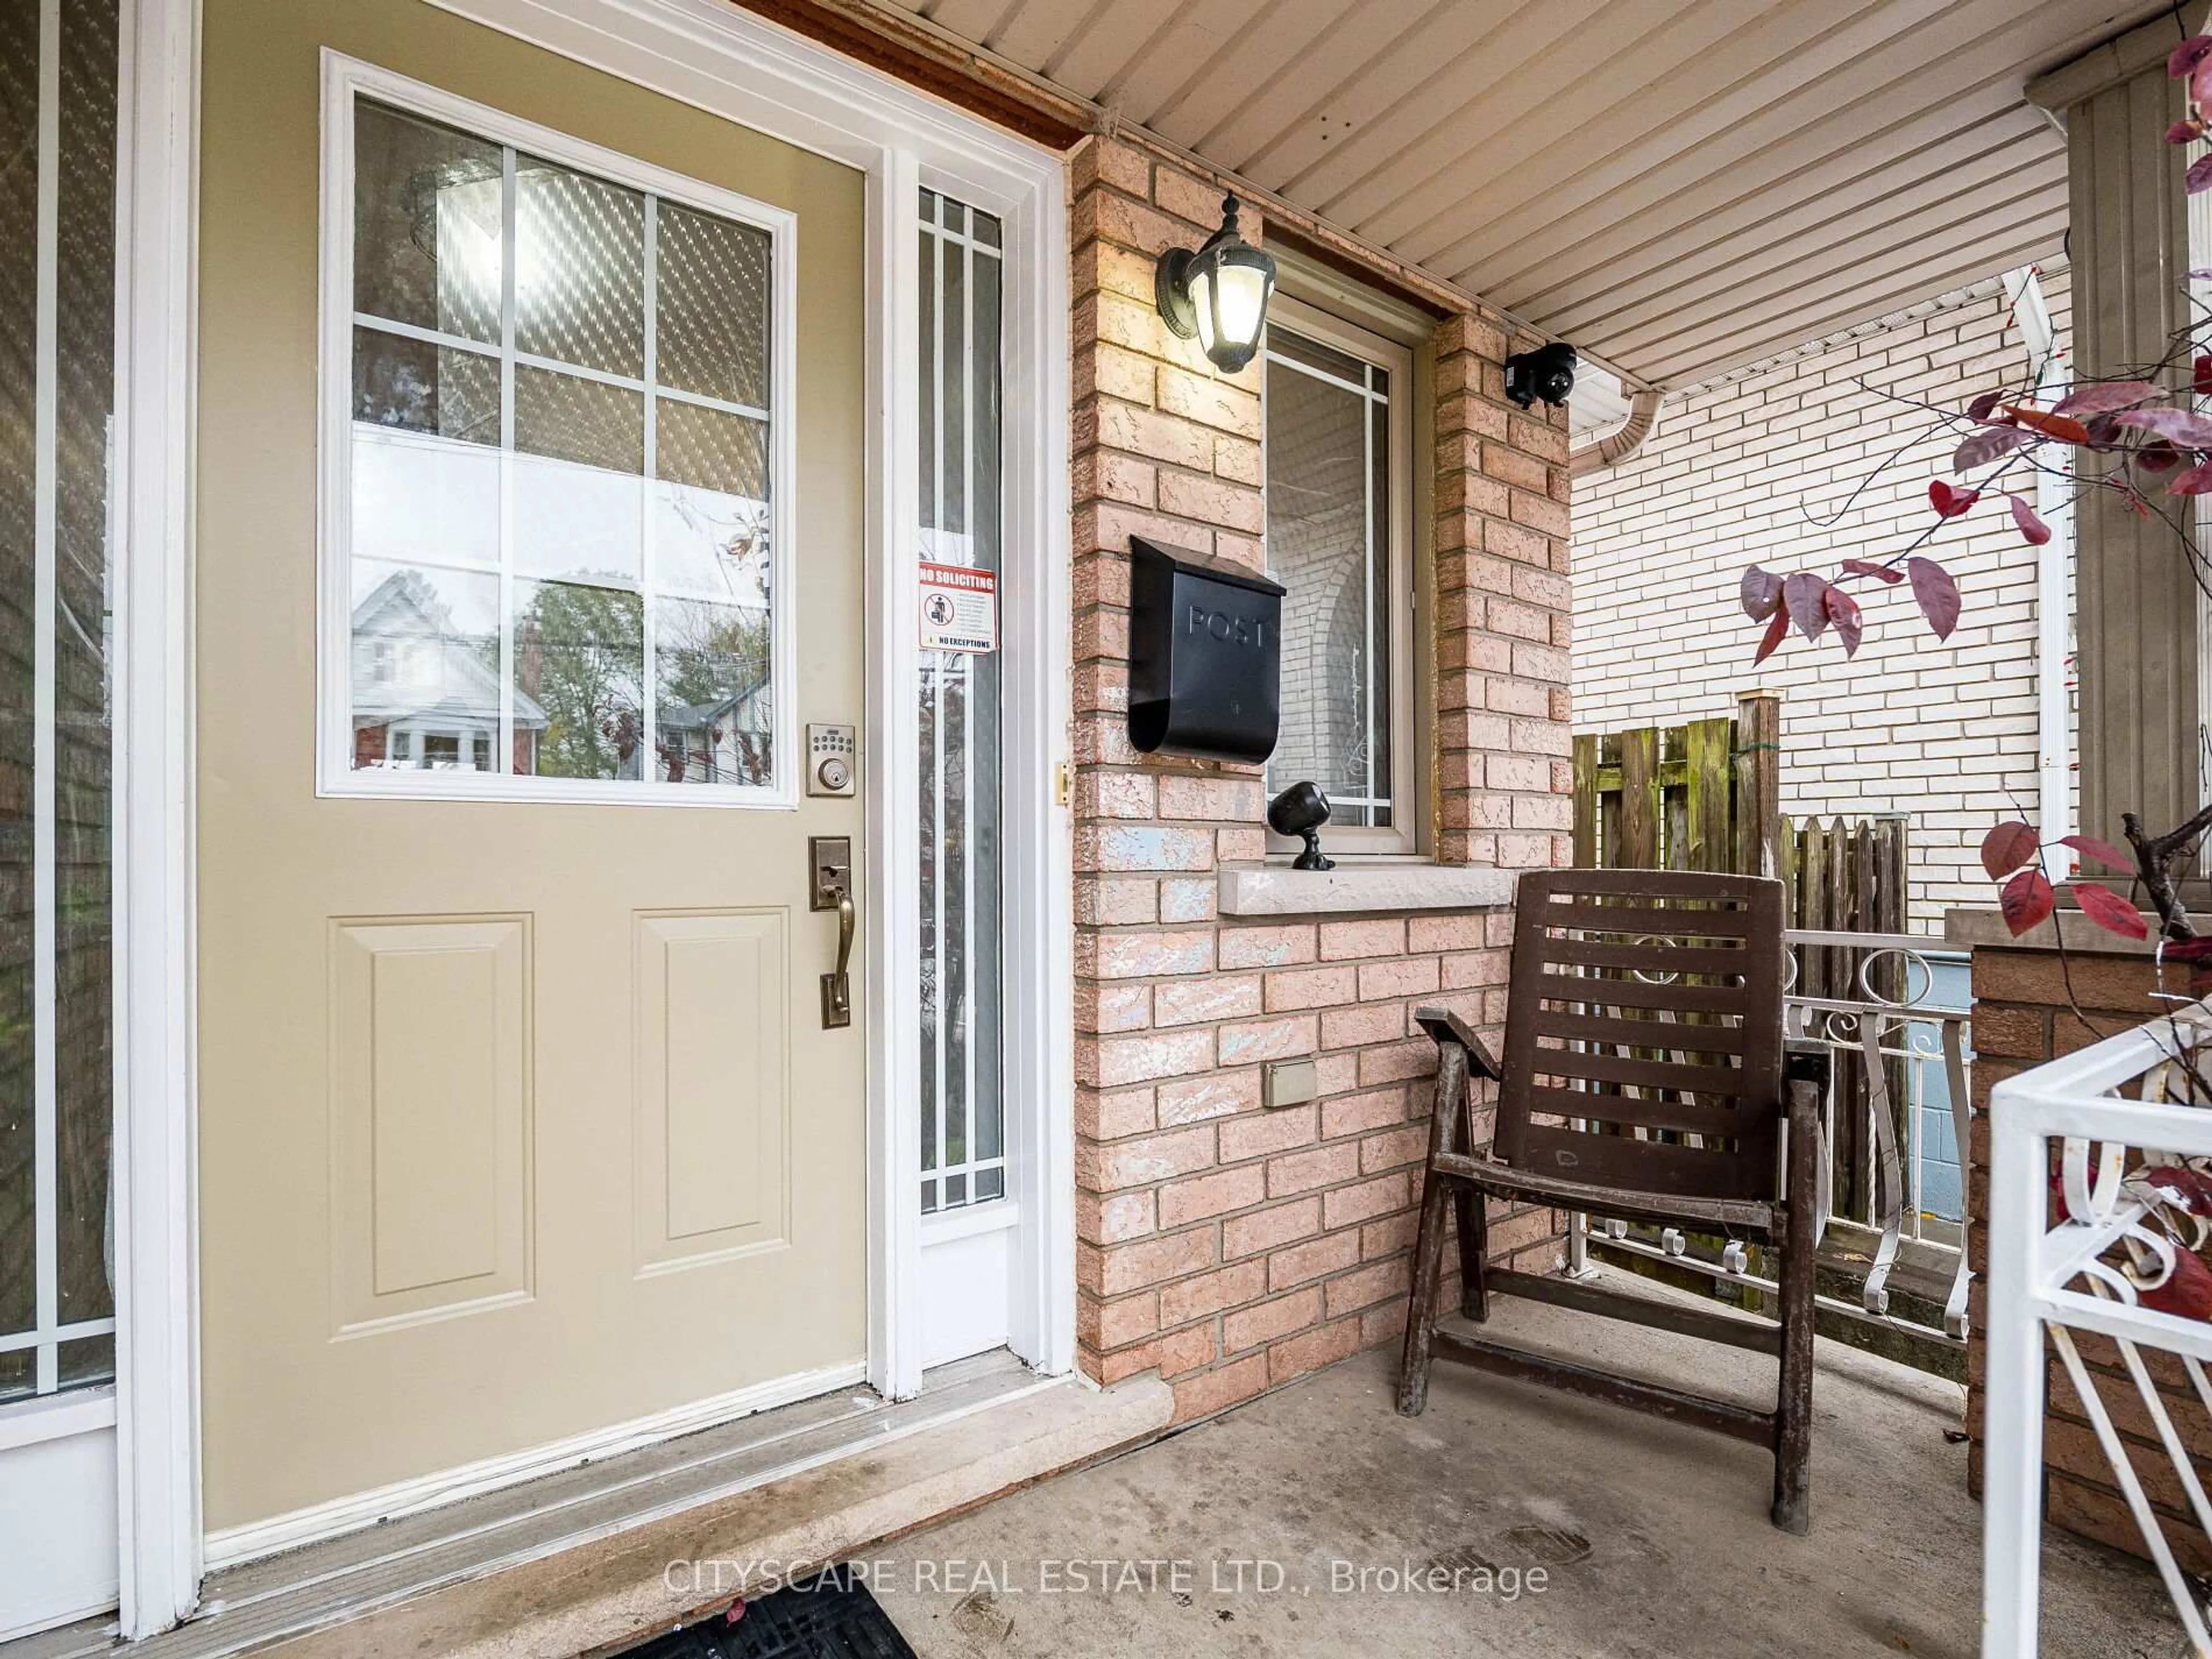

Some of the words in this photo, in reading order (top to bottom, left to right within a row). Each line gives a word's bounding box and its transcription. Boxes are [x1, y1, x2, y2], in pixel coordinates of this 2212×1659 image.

[920, 568, 934, 581] NO
[936, 570, 993, 590] SOLICITING
[1189, 605, 1269, 647] POST
[950, 638, 990, 649] EXCEPTIONS
